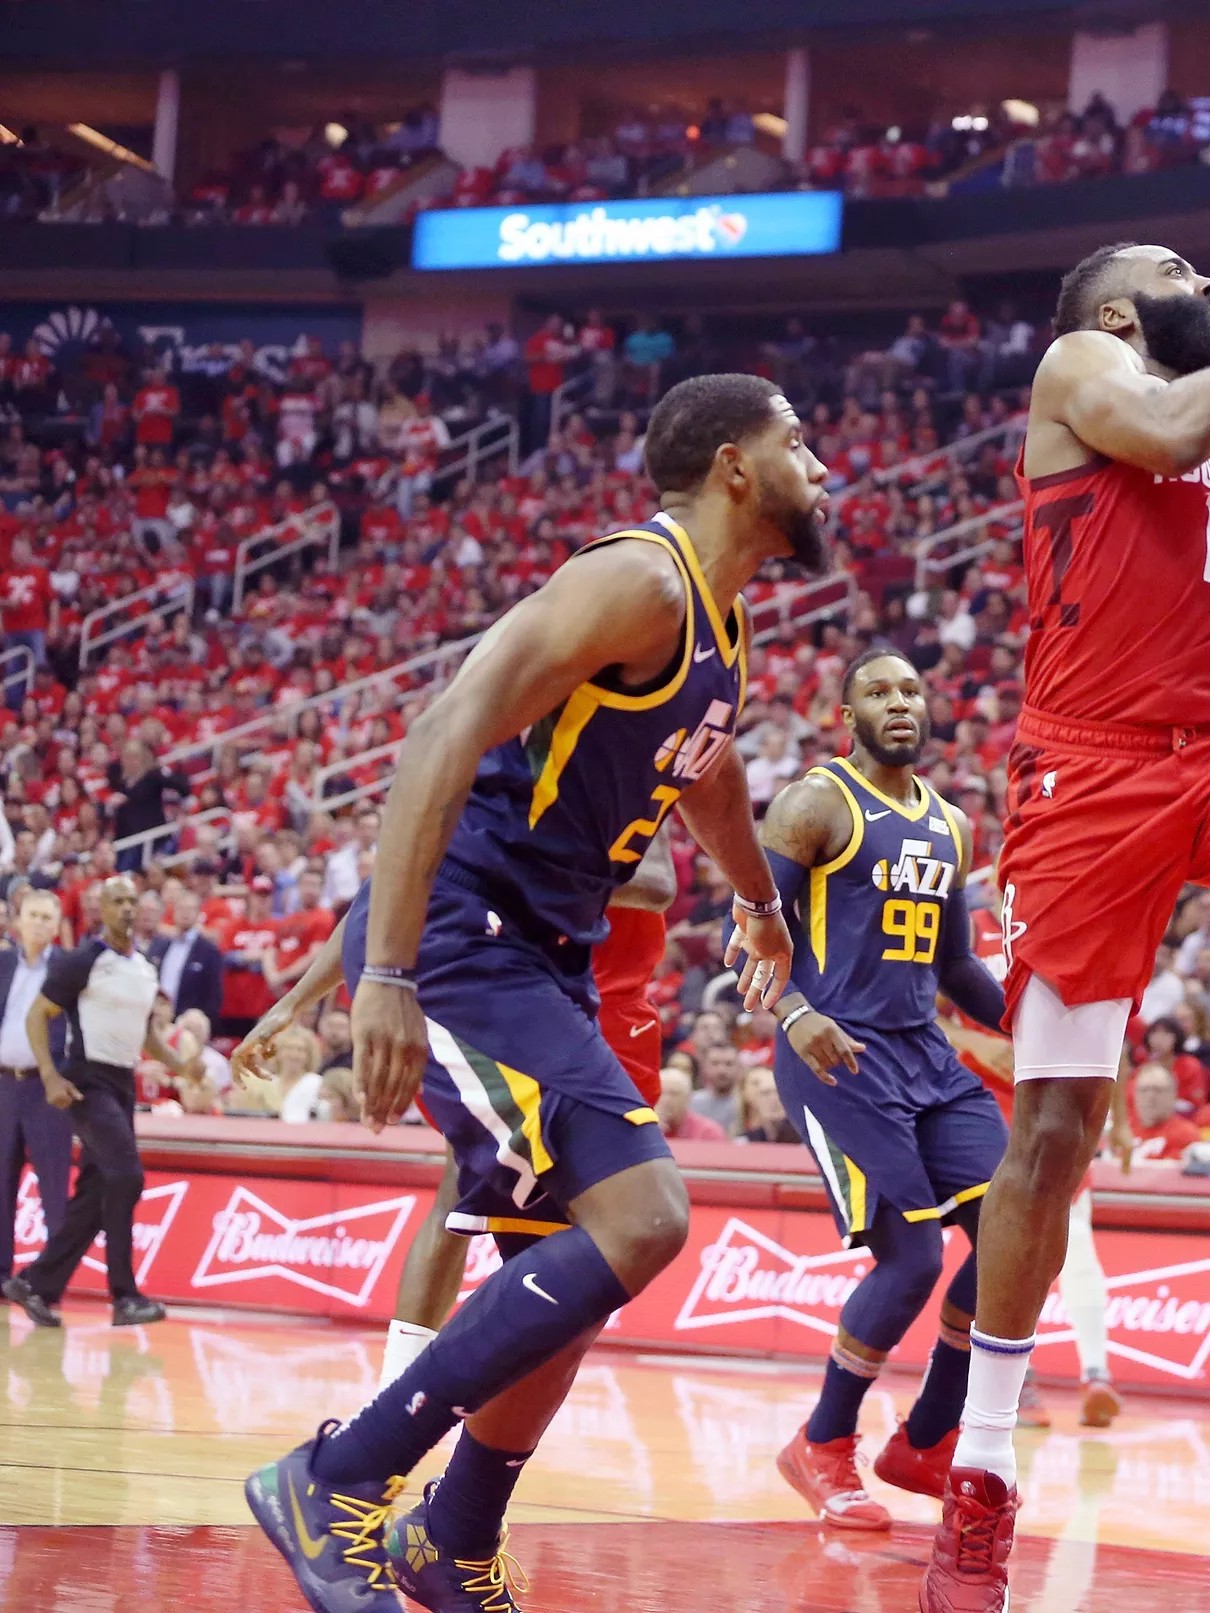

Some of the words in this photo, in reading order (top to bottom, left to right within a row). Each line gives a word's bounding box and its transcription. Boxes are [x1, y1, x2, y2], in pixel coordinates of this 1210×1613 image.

[497, 206, 718, 261] Southwest
[872, 838, 956, 899] JAZZ
[881, 898, 941, 964] 99
[212, 1210, 387, 1268] Budweiser
[699, 1244, 868, 1308] Budwei
